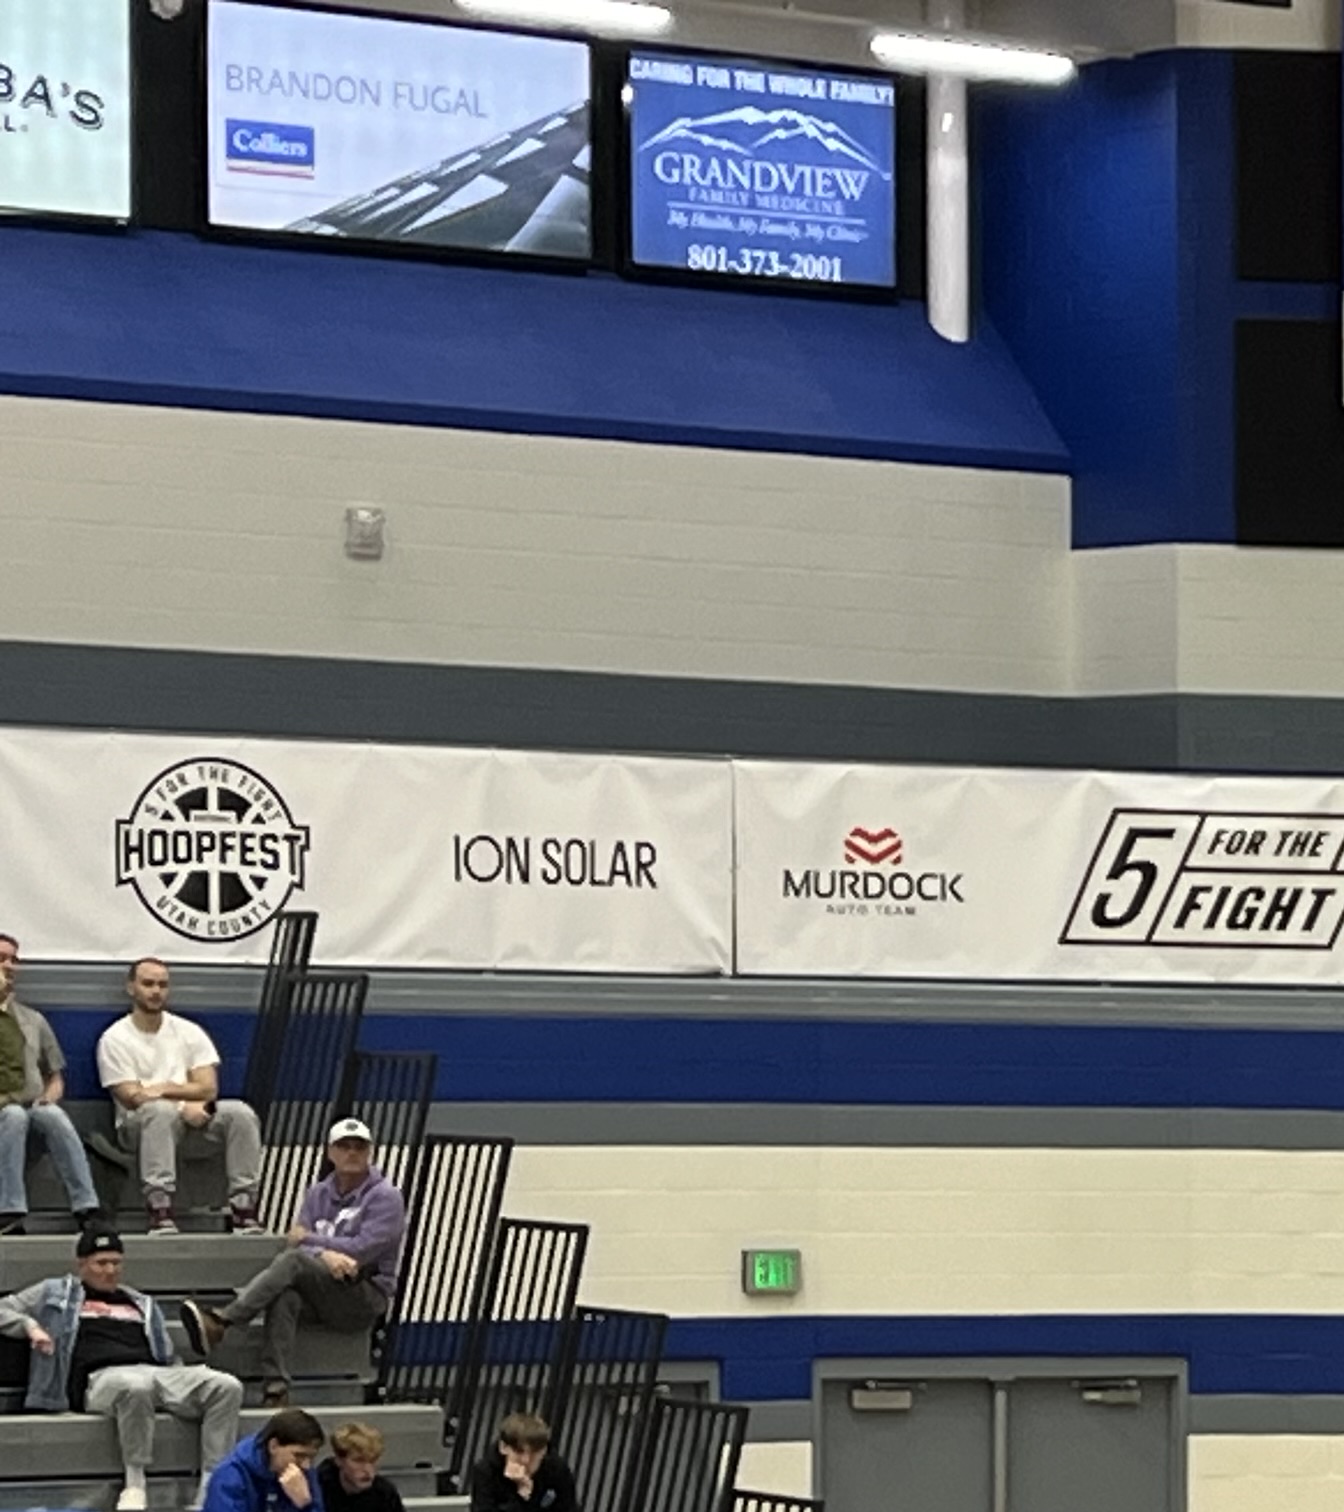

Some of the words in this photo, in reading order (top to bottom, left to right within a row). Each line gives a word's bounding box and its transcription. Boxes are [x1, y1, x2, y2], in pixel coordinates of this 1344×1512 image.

[226, 63, 383, 104] BRANDON
[393, 82, 488, 118] FUGAL
[232, 127, 308, 158] Colliers
[654, 151, 869, 200] GRANDVIEW
[688, 186, 749, 206] FAMILY
[755, 193, 845, 215] MEDICINE
[687, 243, 842, 282] 801-373-2001
[156, 772, 189, 801] FOR
[197, 765, 229, 783] THE
[124, 828, 301, 876] HOOPFEST
[453, 834, 531, 884] ION
[541, 838, 658, 889] SOLAR
[1207, 829, 1265, 857] FOR
[1273, 830, 1330, 858] THE
[783, 869, 965, 903] MURDOCK
[1090, 827, 1177, 929] 5
[156, 895, 199, 930] UTAH
[207, 899, 272, 936] COUNTY
[1173, 885, 1337, 932] FIGHT
